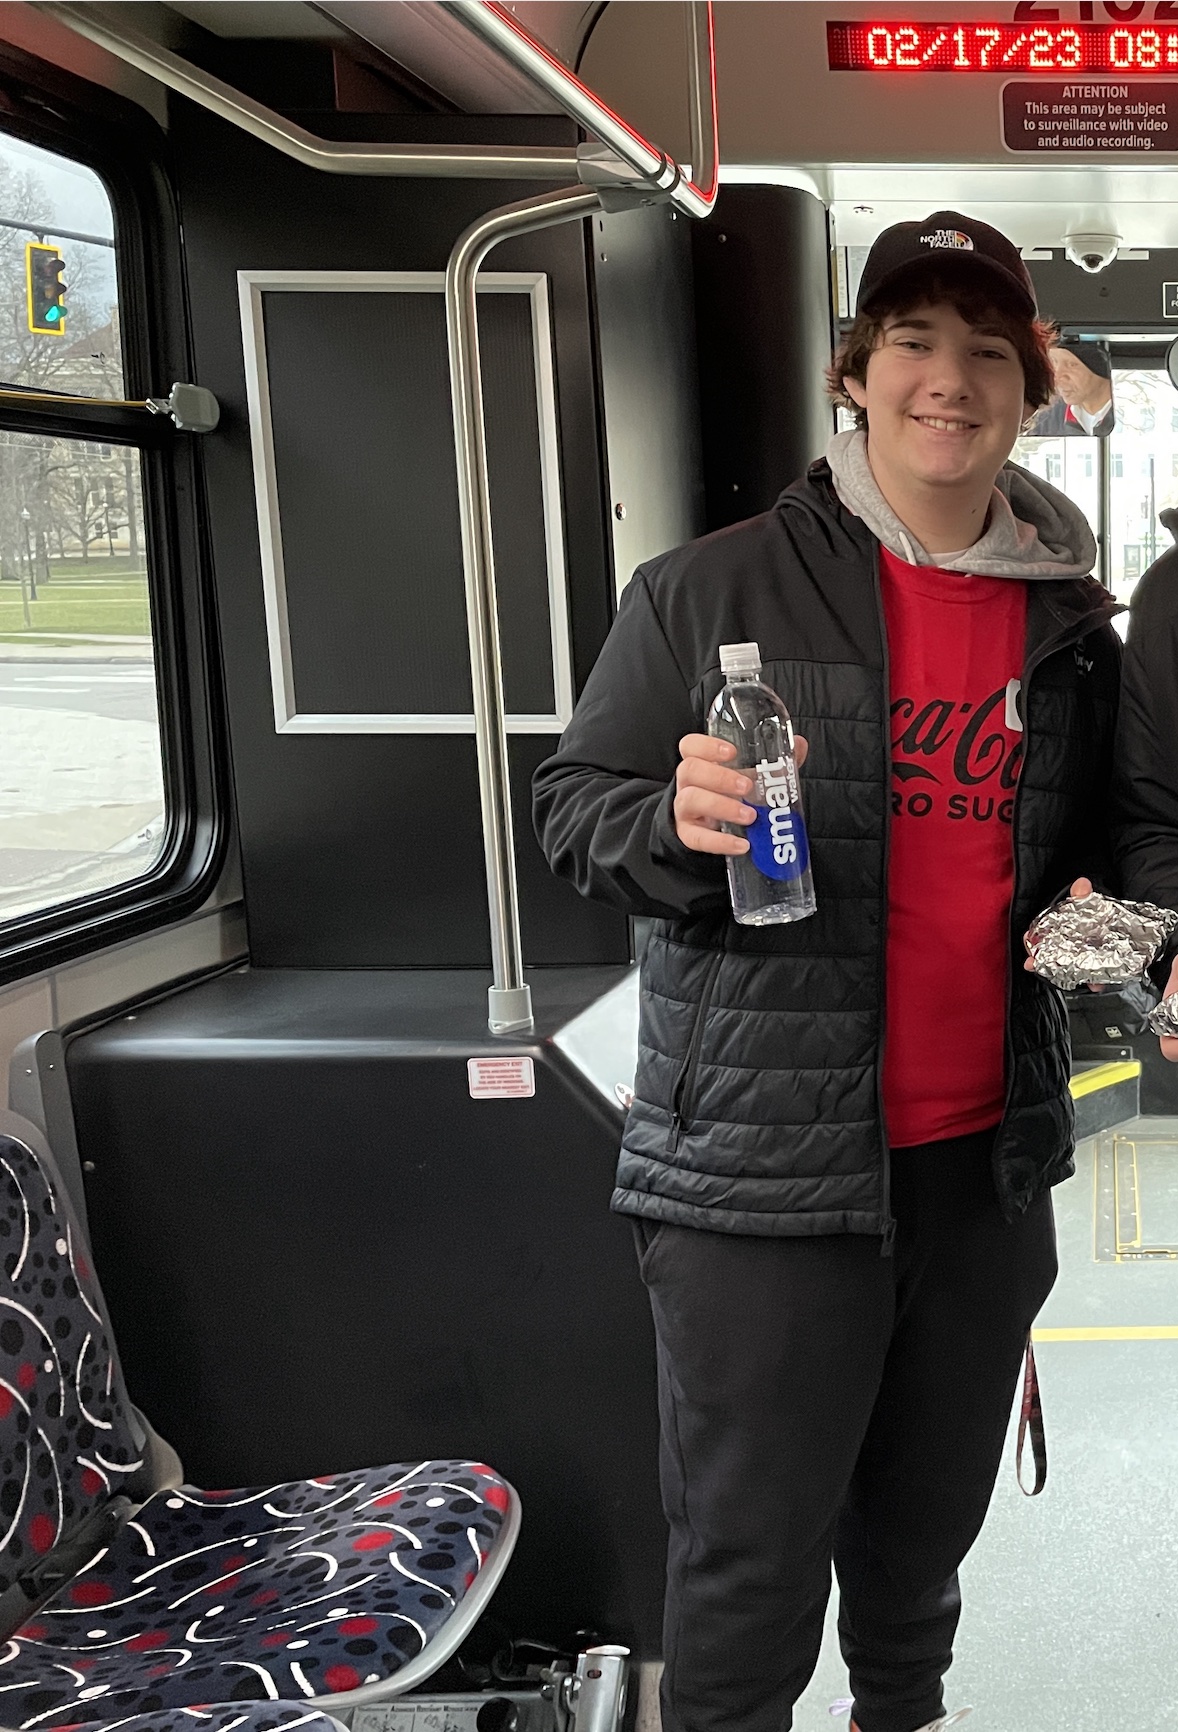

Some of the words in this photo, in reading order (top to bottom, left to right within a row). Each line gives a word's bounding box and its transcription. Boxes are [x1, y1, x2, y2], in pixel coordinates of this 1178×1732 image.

[867, 25, 1081, 67] 02/17/23
[1062, 85, 1129, 98] ATTENTION
[1025, 102, 1049, 114] This
[1052, 104, 1077, 114] area
[1080, 104, 1105, 117] may
[1108, 102, 1122, 114] be
[1124, 102, 1166, 117] subject
[1023, 119, 1035, 130] to
[1038, 118, 1106, 131] surveillance
[1109, 118, 1134, 131] with
[1136, 118, 1168, 131] video
[1037, 135, 1059, 147] and
[1062, 135, 1094, 147] audio
[1097, 135, 1155, 150] recording.
[920, 235, 955, 243] NORTH
[785, 756, 799, 804] water
[755, 756, 797, 865] smart
[892, 792, 933, 817] RO
[947, 794, 1013, 823] SUG
